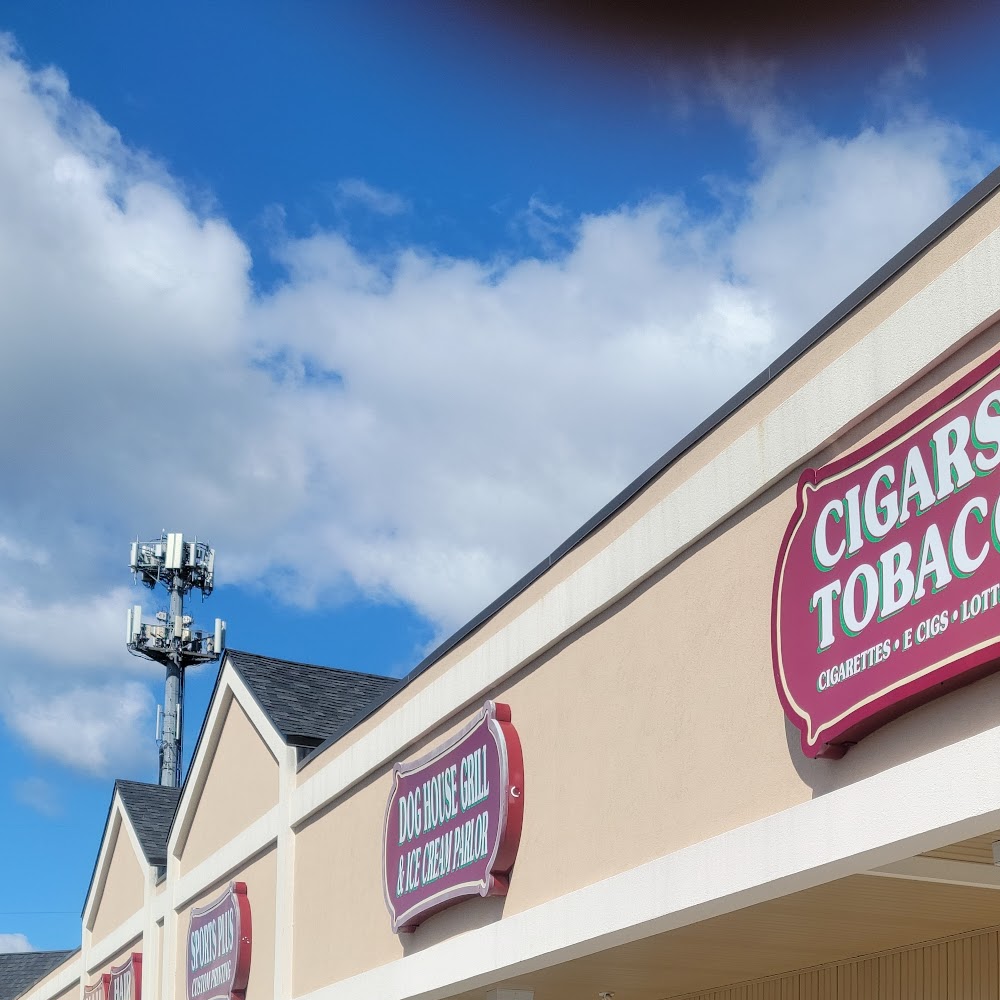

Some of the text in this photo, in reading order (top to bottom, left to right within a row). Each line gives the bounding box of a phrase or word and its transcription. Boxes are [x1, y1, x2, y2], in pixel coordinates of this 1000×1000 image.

[817, 638, 891, 692] CIGARETTES
[902, 628, 913, 652] E
[915, 611, 949, 645] CIGS
[398, 744, 490, 846] DOG HOUSE GRILL
[396, 810, 489, 898] & ICE CREAM PARLOR
[191, 908, 234, 972] SPORTS PLUS
